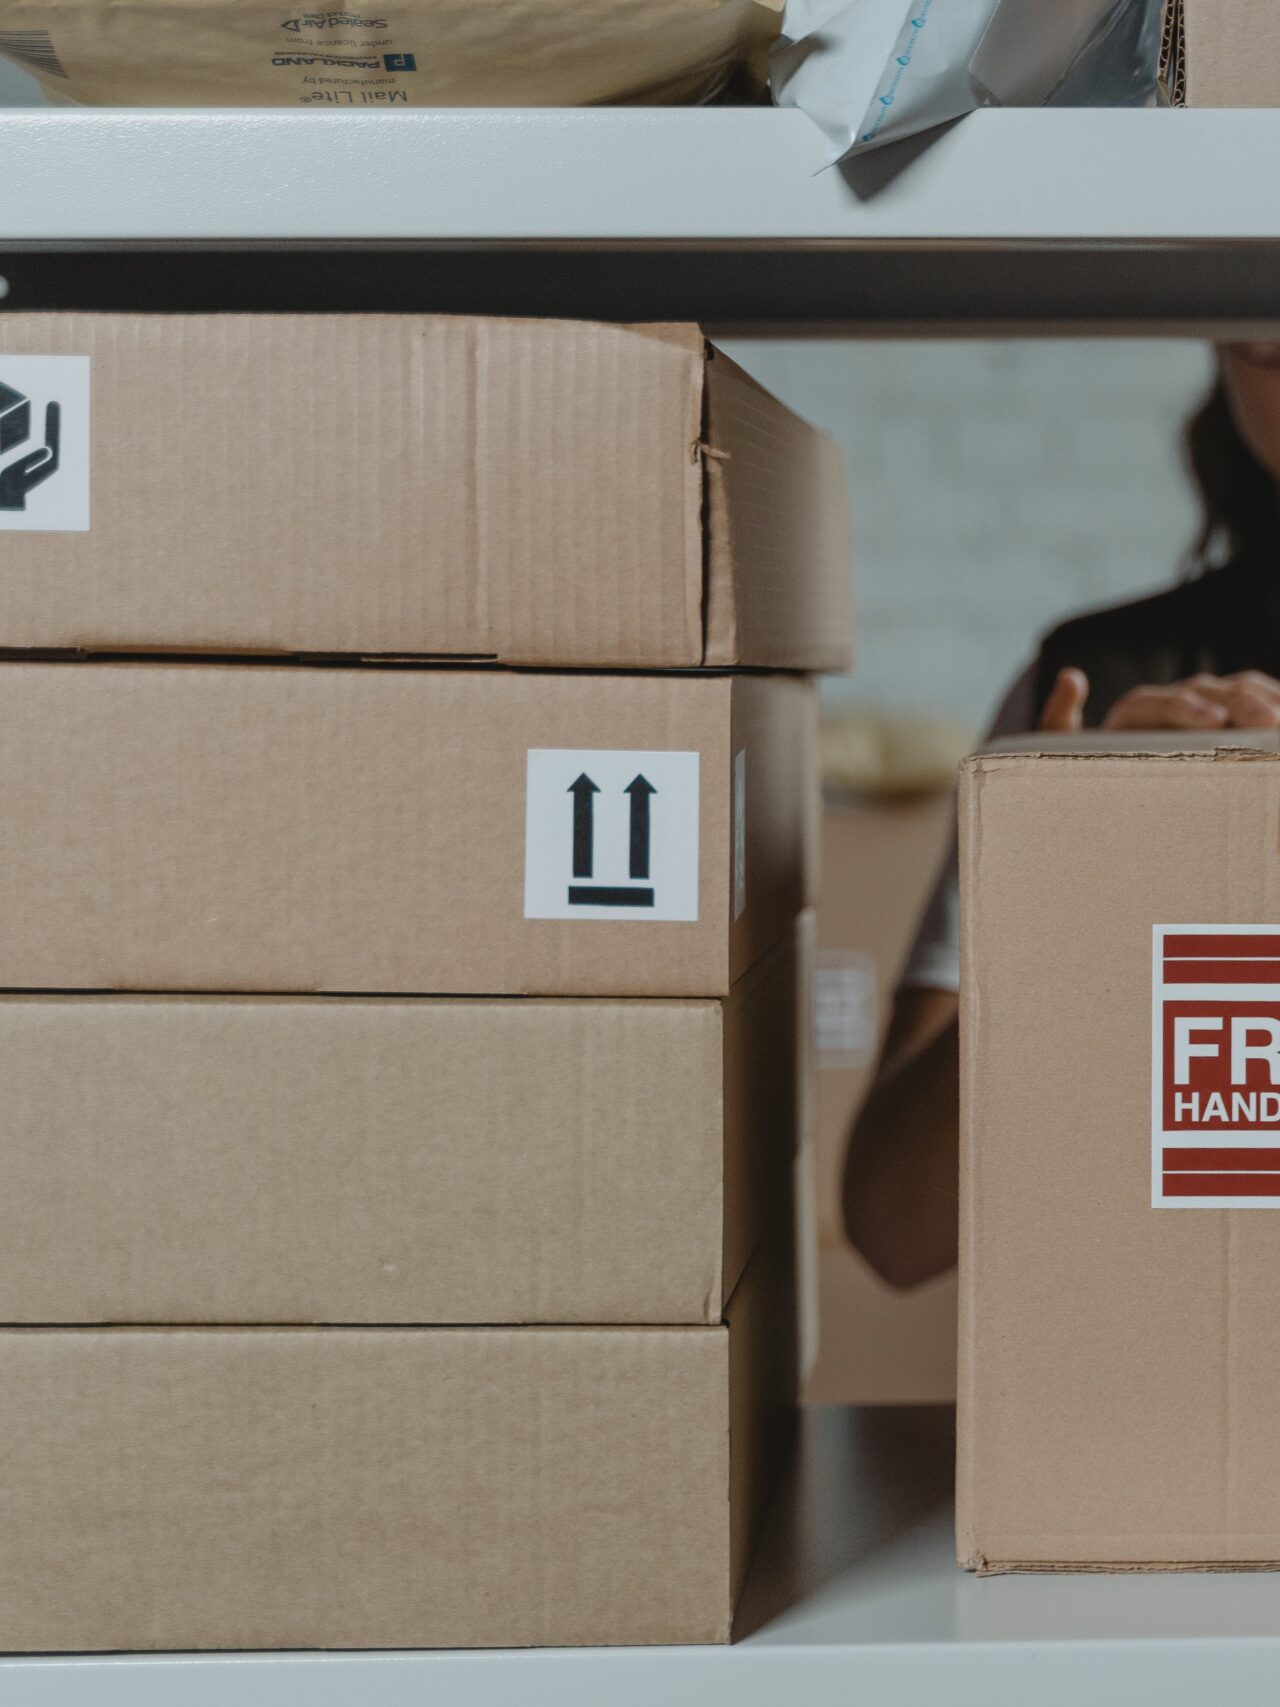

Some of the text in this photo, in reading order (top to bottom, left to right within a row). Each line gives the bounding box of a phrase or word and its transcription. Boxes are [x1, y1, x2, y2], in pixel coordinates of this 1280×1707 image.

[302, 18, 388, 29] Sealed Air
[286, 37, 393, 48] under licence from
[271, 57, 381, 69] PACKLAND
[302, 76, 395, 87] manufactured by
[362, 90, 407, 103] Mail
